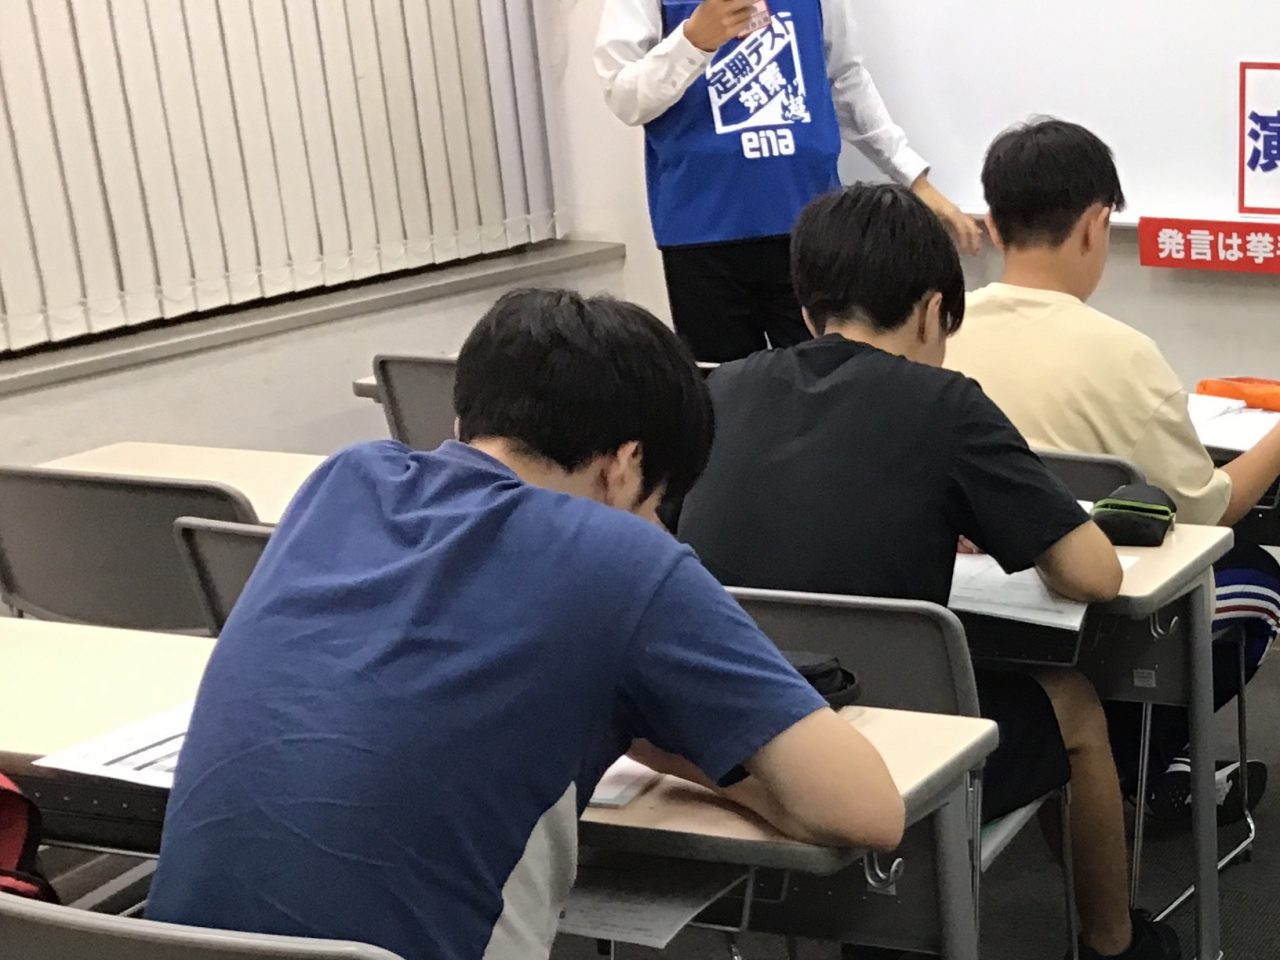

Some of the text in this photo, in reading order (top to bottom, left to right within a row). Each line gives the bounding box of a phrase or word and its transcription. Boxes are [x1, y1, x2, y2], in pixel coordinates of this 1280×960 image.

[709, 14, 792, 99] 定期テスト
[741, 128, 795, 159] ena
